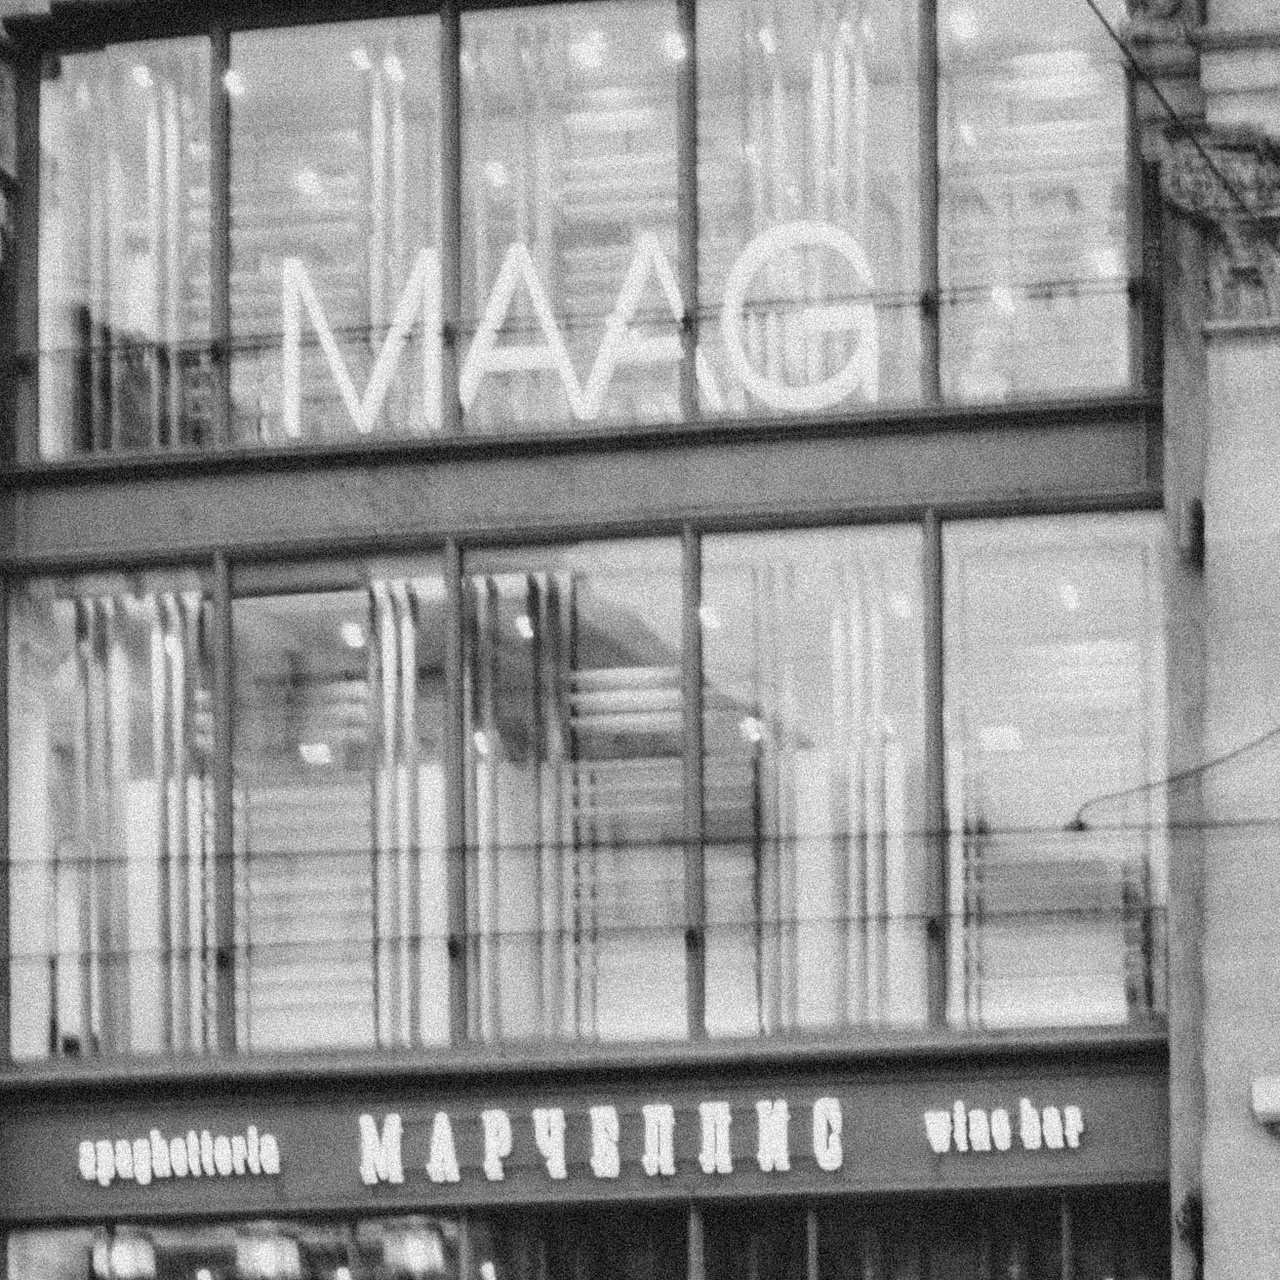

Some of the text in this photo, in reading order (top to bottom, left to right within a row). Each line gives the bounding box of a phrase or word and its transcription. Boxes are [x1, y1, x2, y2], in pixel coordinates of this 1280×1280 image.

[281, 219, 880, 438] MAAG
[922, 1097, 1085, 1153] wine bar
